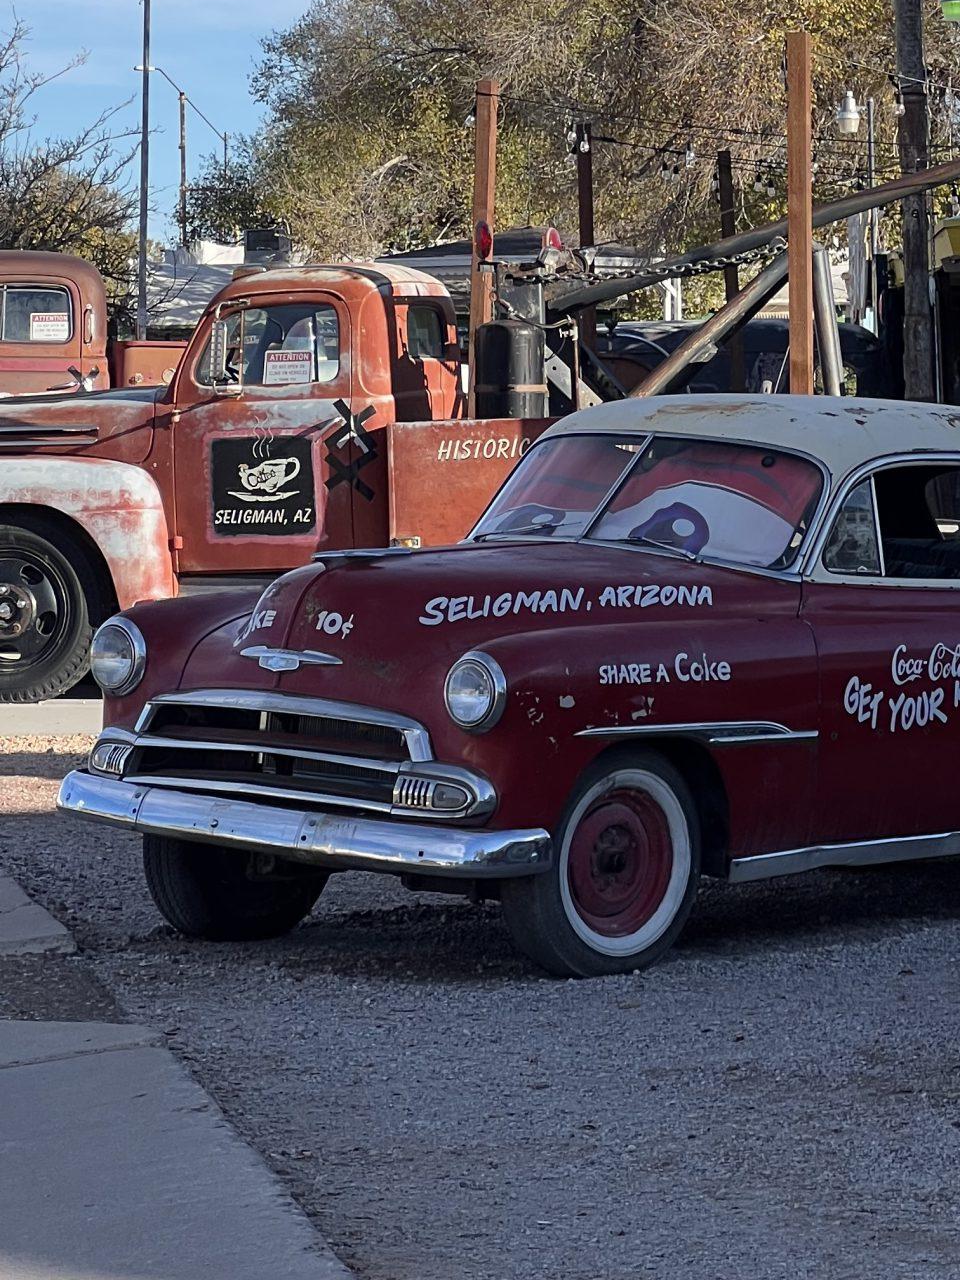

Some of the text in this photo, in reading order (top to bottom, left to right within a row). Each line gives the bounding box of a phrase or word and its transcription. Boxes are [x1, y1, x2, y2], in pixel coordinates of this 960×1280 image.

[269, 352, 309, 362] ATTENTION
[437, 434, 530, 461] HISTORIC
[214, 507, 312, 526] SELIGMAN, AZ
[418, 584, 713, 626] SELIGMAN, ARIZONA
[316, 610, 354, 640] 10¢
[599, 652, 731, 685] SHARE A Coke
[843, 676, 884, 730] GET
[888, 687, 948, 732] YOUR
